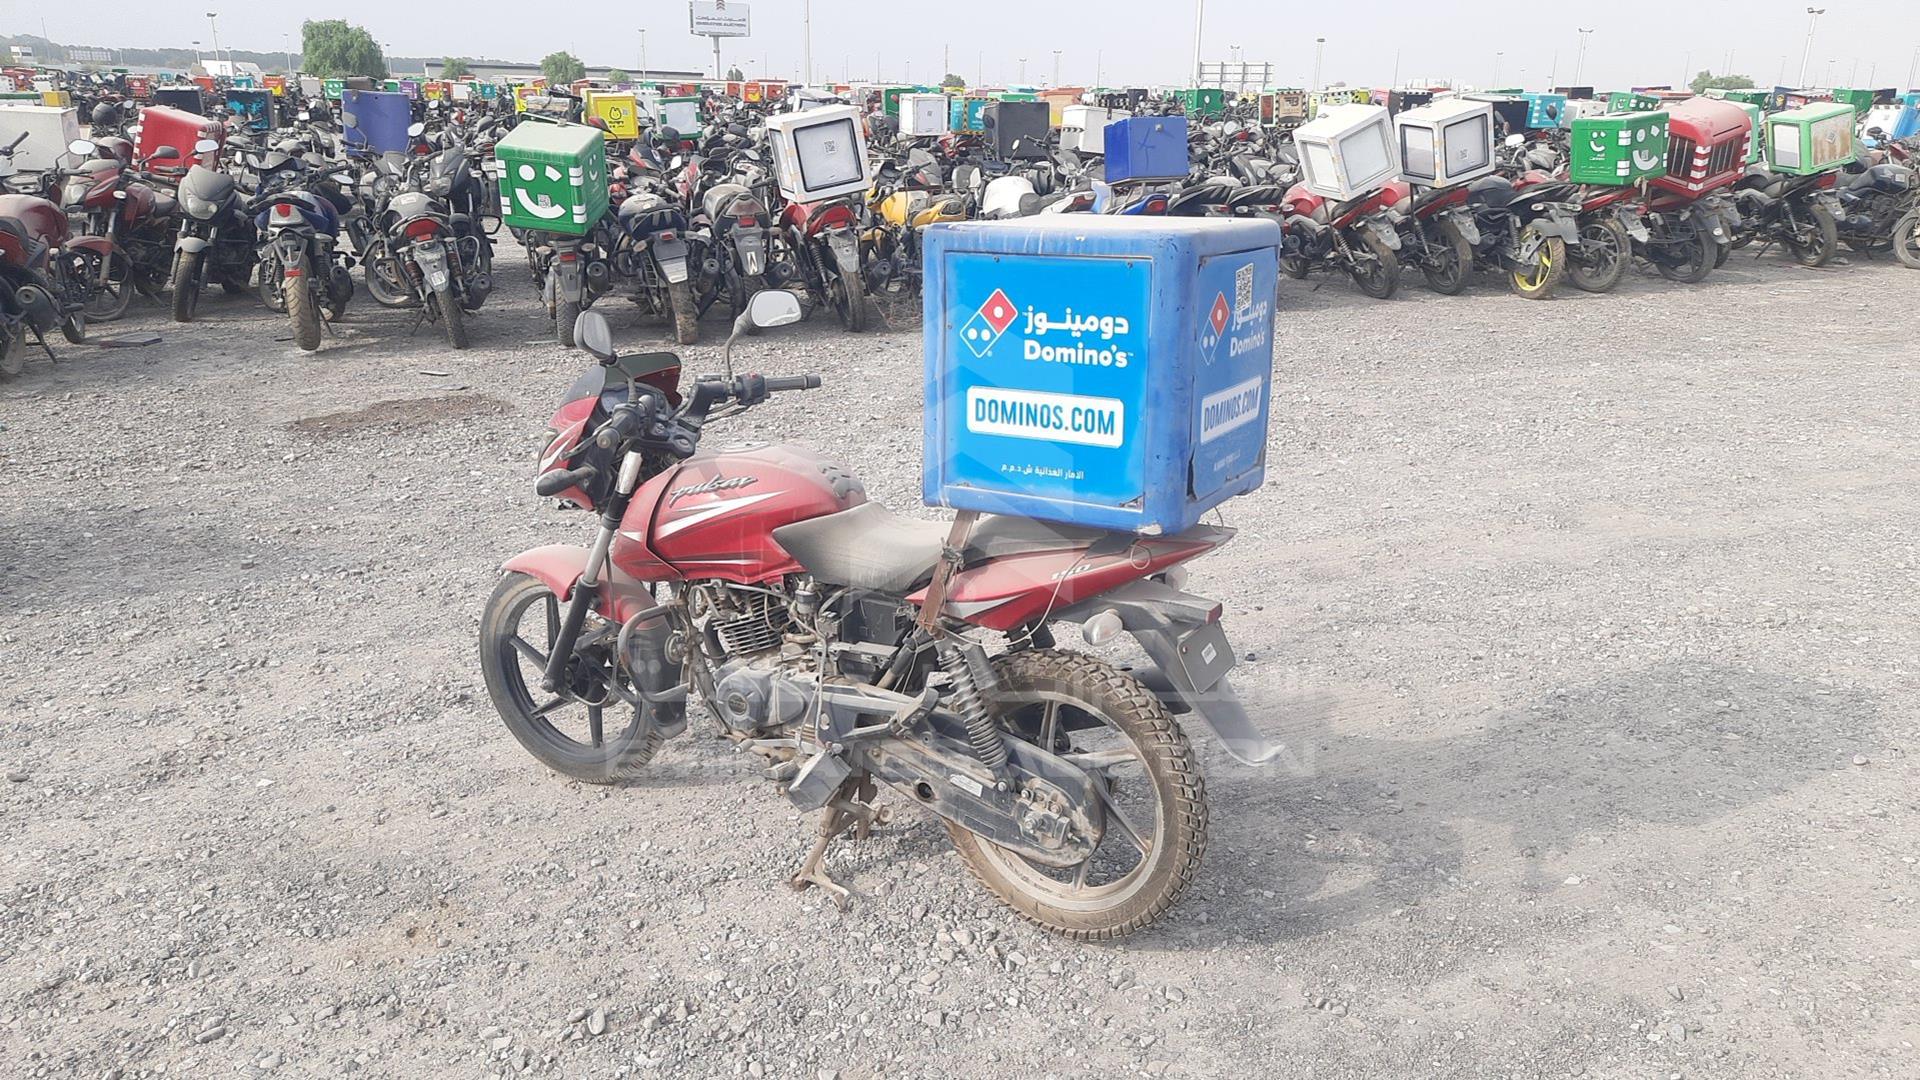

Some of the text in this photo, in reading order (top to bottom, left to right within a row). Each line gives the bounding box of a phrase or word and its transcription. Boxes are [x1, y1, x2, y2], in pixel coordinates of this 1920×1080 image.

[1023, 305, 1129, 339] دومينوز
[1023, 339, 1128, 368] Domino's
[974, 397, 1116, 436] DOMINOS.COM
[1203, 385, 1260, 433] DOMINOS.COM
